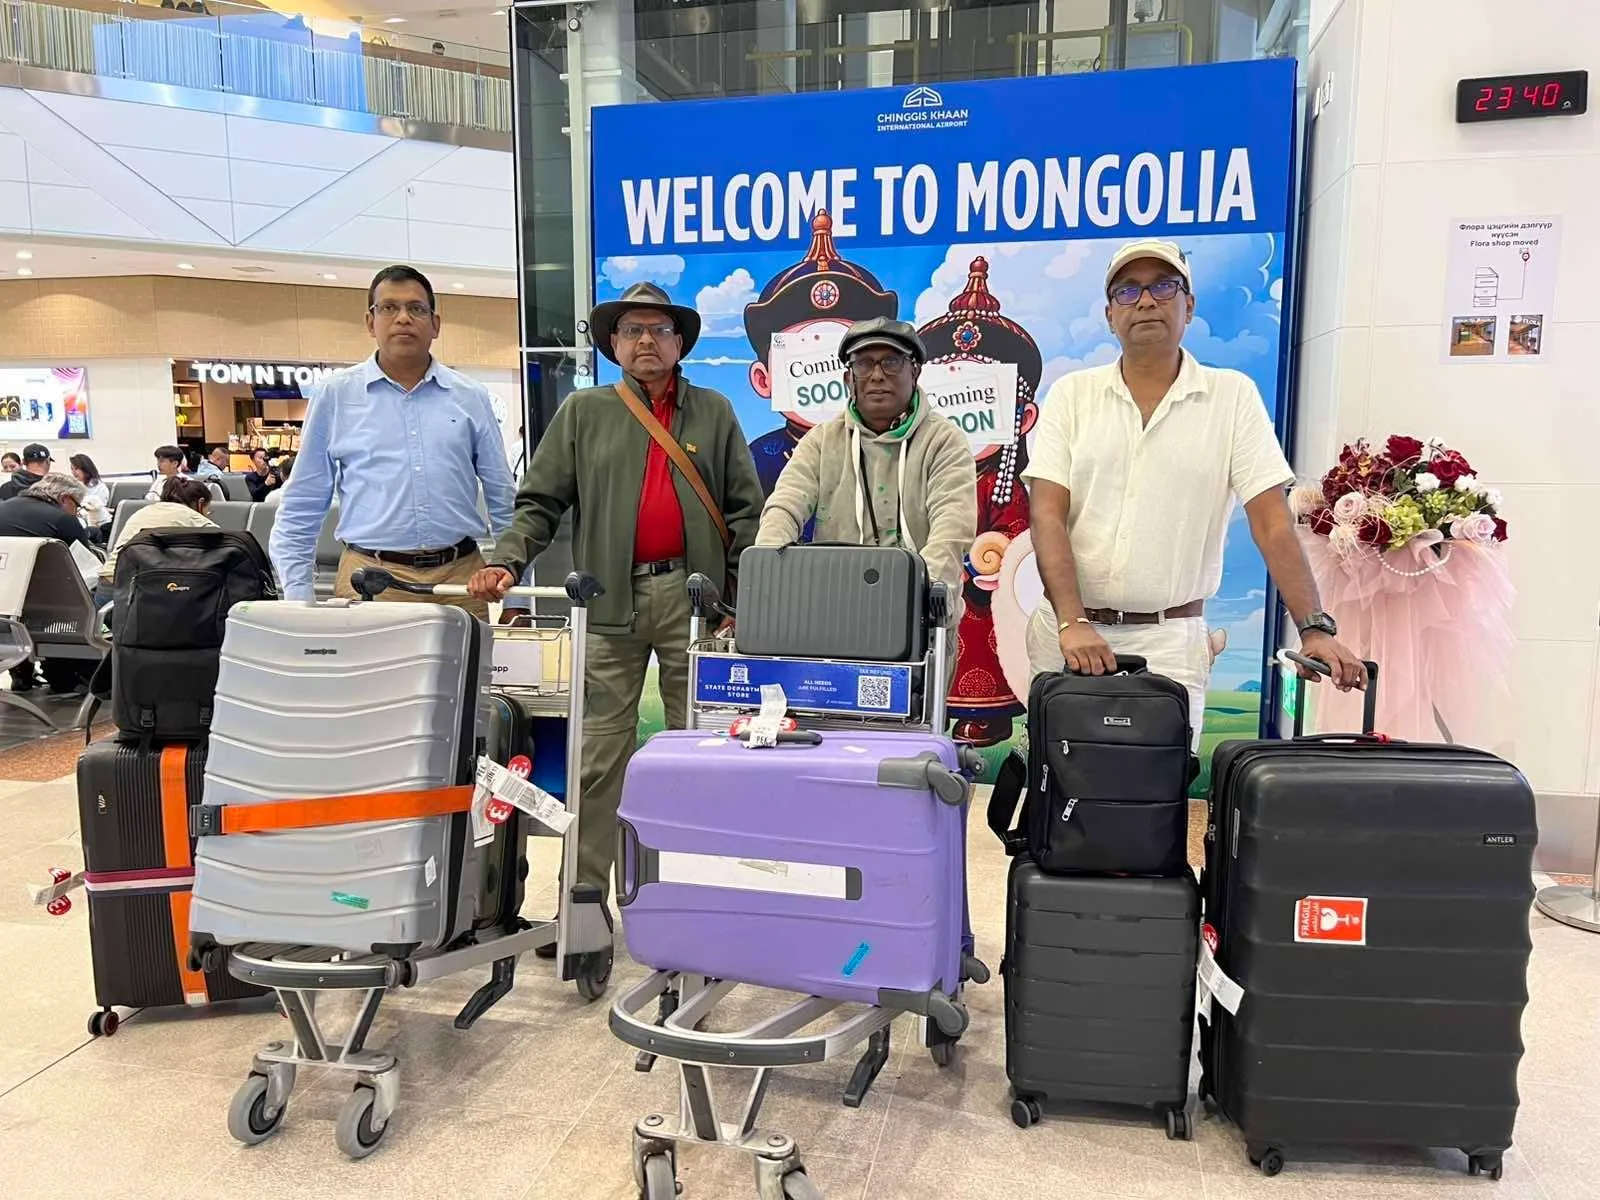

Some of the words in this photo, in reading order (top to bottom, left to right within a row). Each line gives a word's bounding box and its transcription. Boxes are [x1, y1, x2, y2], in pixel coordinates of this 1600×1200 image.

[877, 111, 928, 123] CHINGGIS
[930, 109, 969, 120] KHAAN
[877, 122, 935, 131] INTERNATIONAL
[936, 120, 968, 128] AIRPORT
[622, 168, 857, 246] WELCOME
[873, 163, 939, 236] TO
[956, 147, 1257, 233] MONGOLIA
[1459, 223, 1485, 231] Флора
[1491, 239, 1511, 247] shop
[1512, 238, 1539, 246] moved
[192, 363, 251, 384] TOM
[255, 365, 276, 385] N
[789, 354, 842, 378] Comi
[927, 385, 996, 409] oming
[1485, 836, 1515, 844] ANTLER
[1301, 899, 1310, 937] FRAGILE
